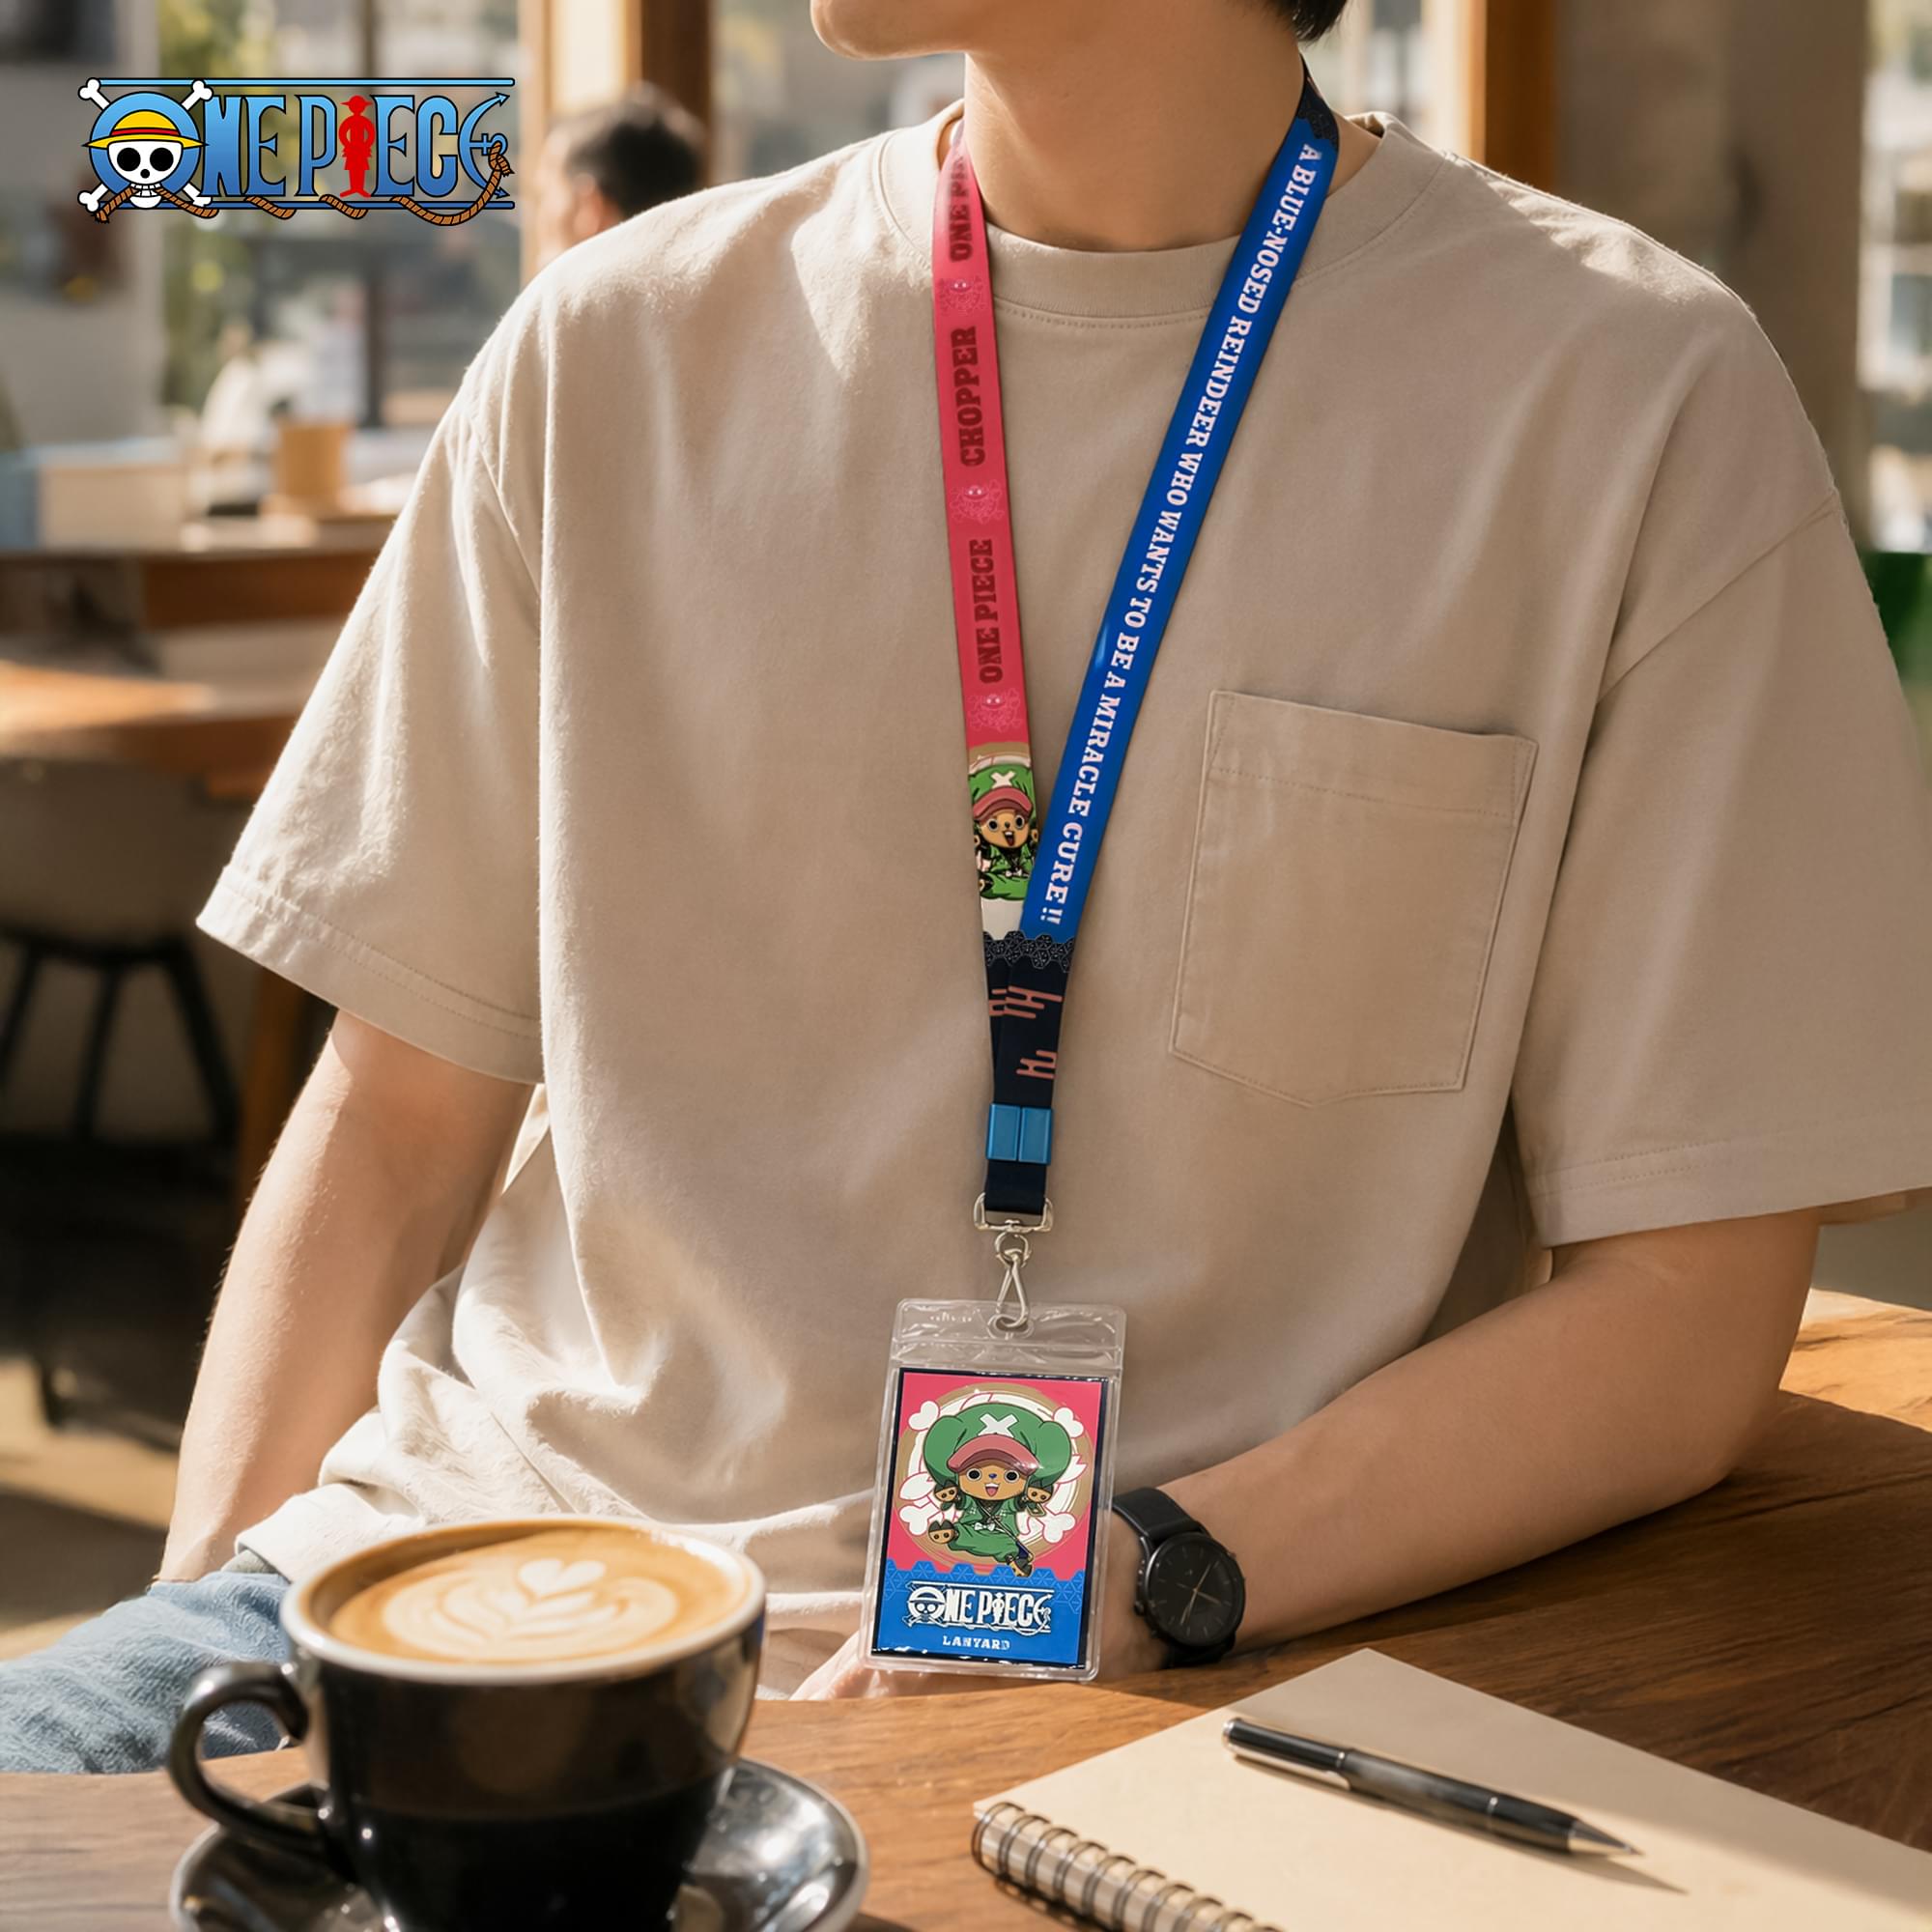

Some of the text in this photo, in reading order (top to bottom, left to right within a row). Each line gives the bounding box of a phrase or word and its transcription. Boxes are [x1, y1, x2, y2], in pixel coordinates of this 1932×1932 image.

[1299, 144, 1321, 161] A
[949, 204, 974, 263] ONE
[1237, 164, 1317, 315] BLUE-NOSED
[951, 326, 985, 468] CHOPPER
[1185, 315, 1253, 447] REINDEER
[1166, 453, 1204, 507] WHO
[1136, 511, 1182, 594] WANTS
[969, 538, 1004, 684] ONE PIECE
[1124, 597, 1152, 629] TO
[1104, 670, 1126, 689] A
[1111, 632, 1140, 670] BE
[1068, 694, 1121, 817] MIRACLE
[942, 1635, 1010, 1651] LANYARD
